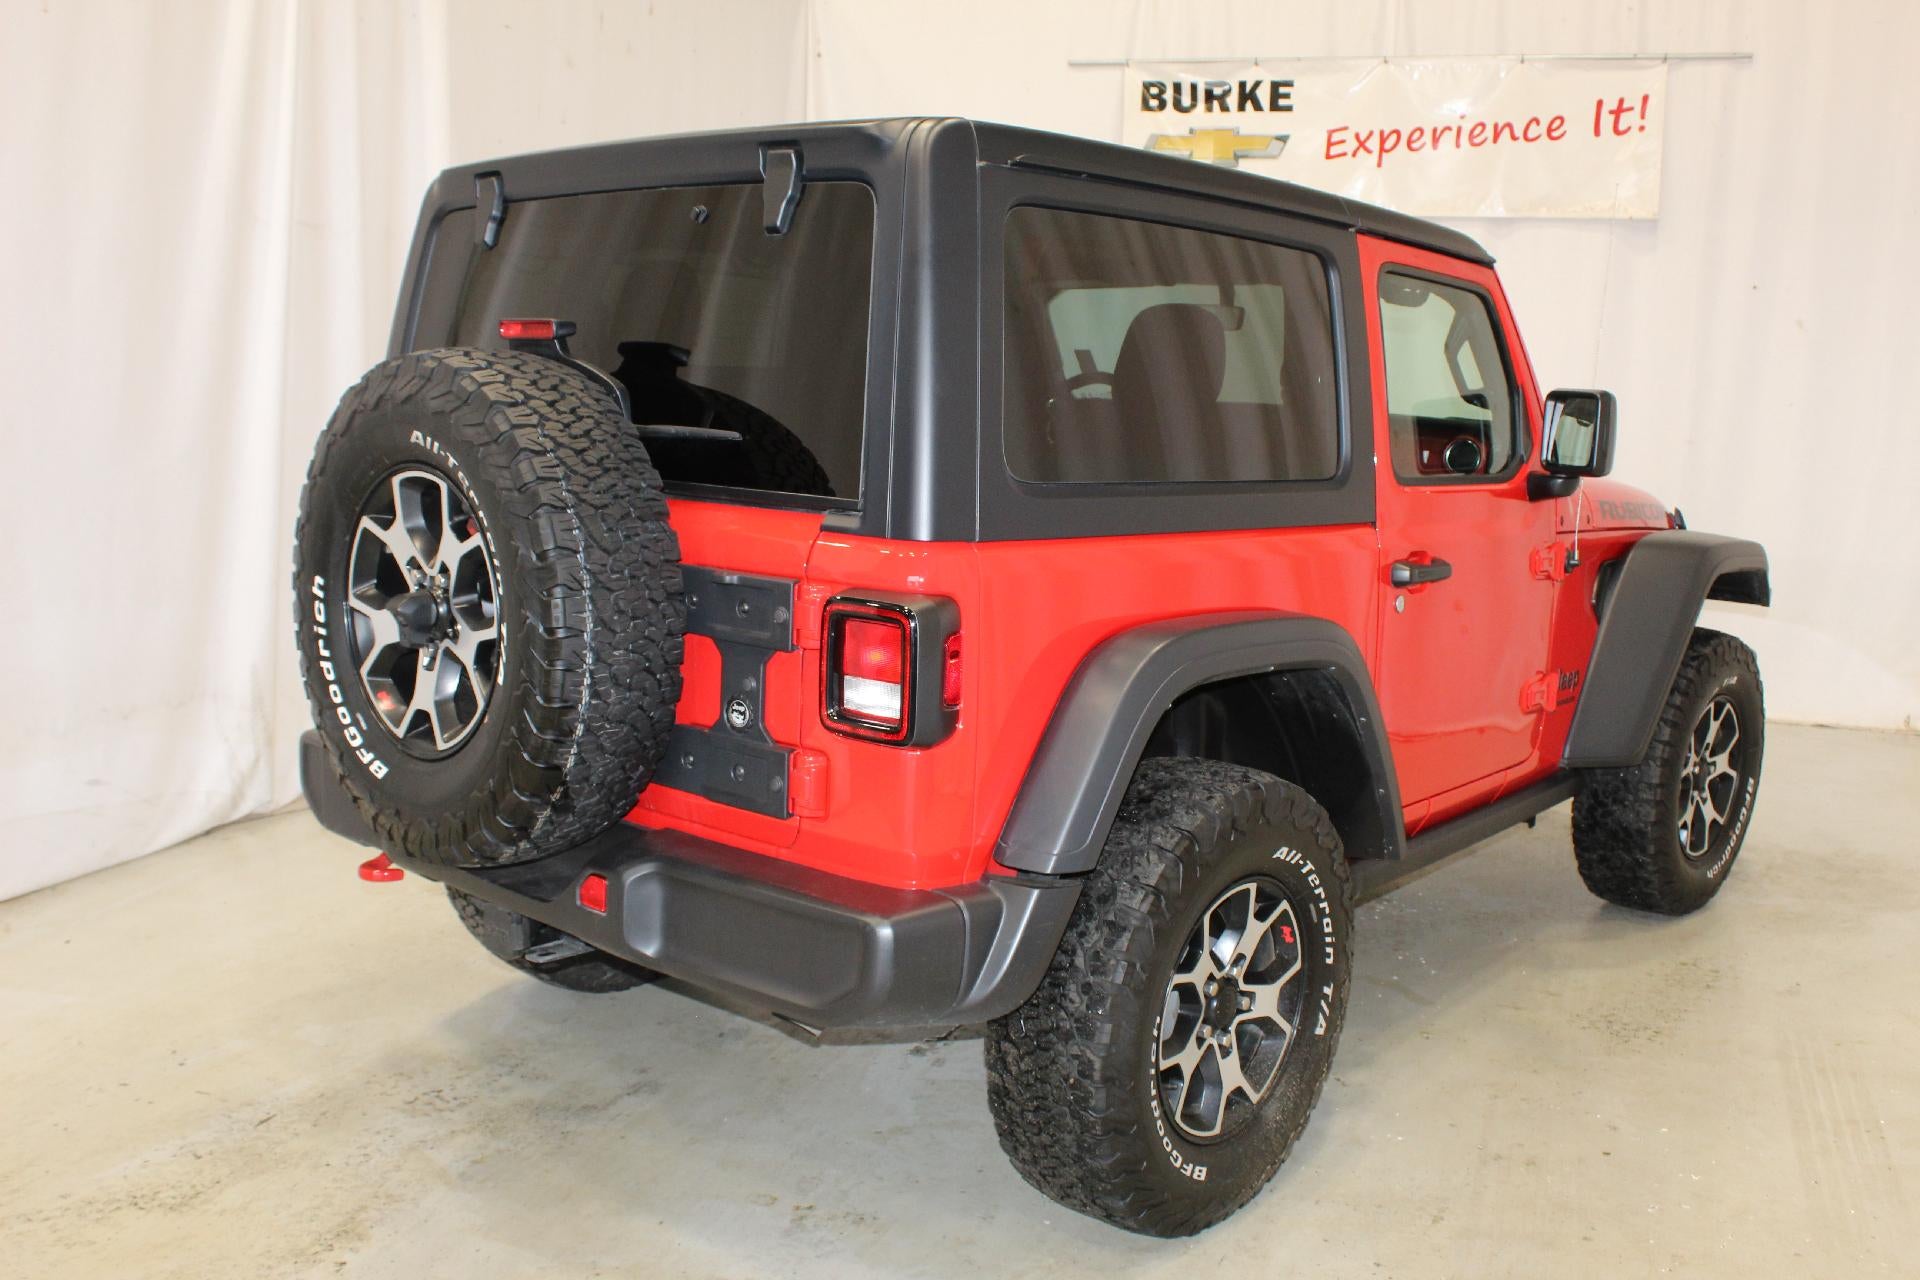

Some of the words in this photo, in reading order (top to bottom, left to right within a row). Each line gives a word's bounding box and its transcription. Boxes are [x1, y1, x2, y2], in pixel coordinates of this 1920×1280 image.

[1141, 79, 1294, 113] BURKE
[1324, 112, 1568, 167] Experience
[1592, 94, 1651, 138] It!
[312, 575, 390, 780] BFGoodrich
[1272, 846, 1336, 965] All-Terrain
[1313, 982, 1335, 1036] T/A
